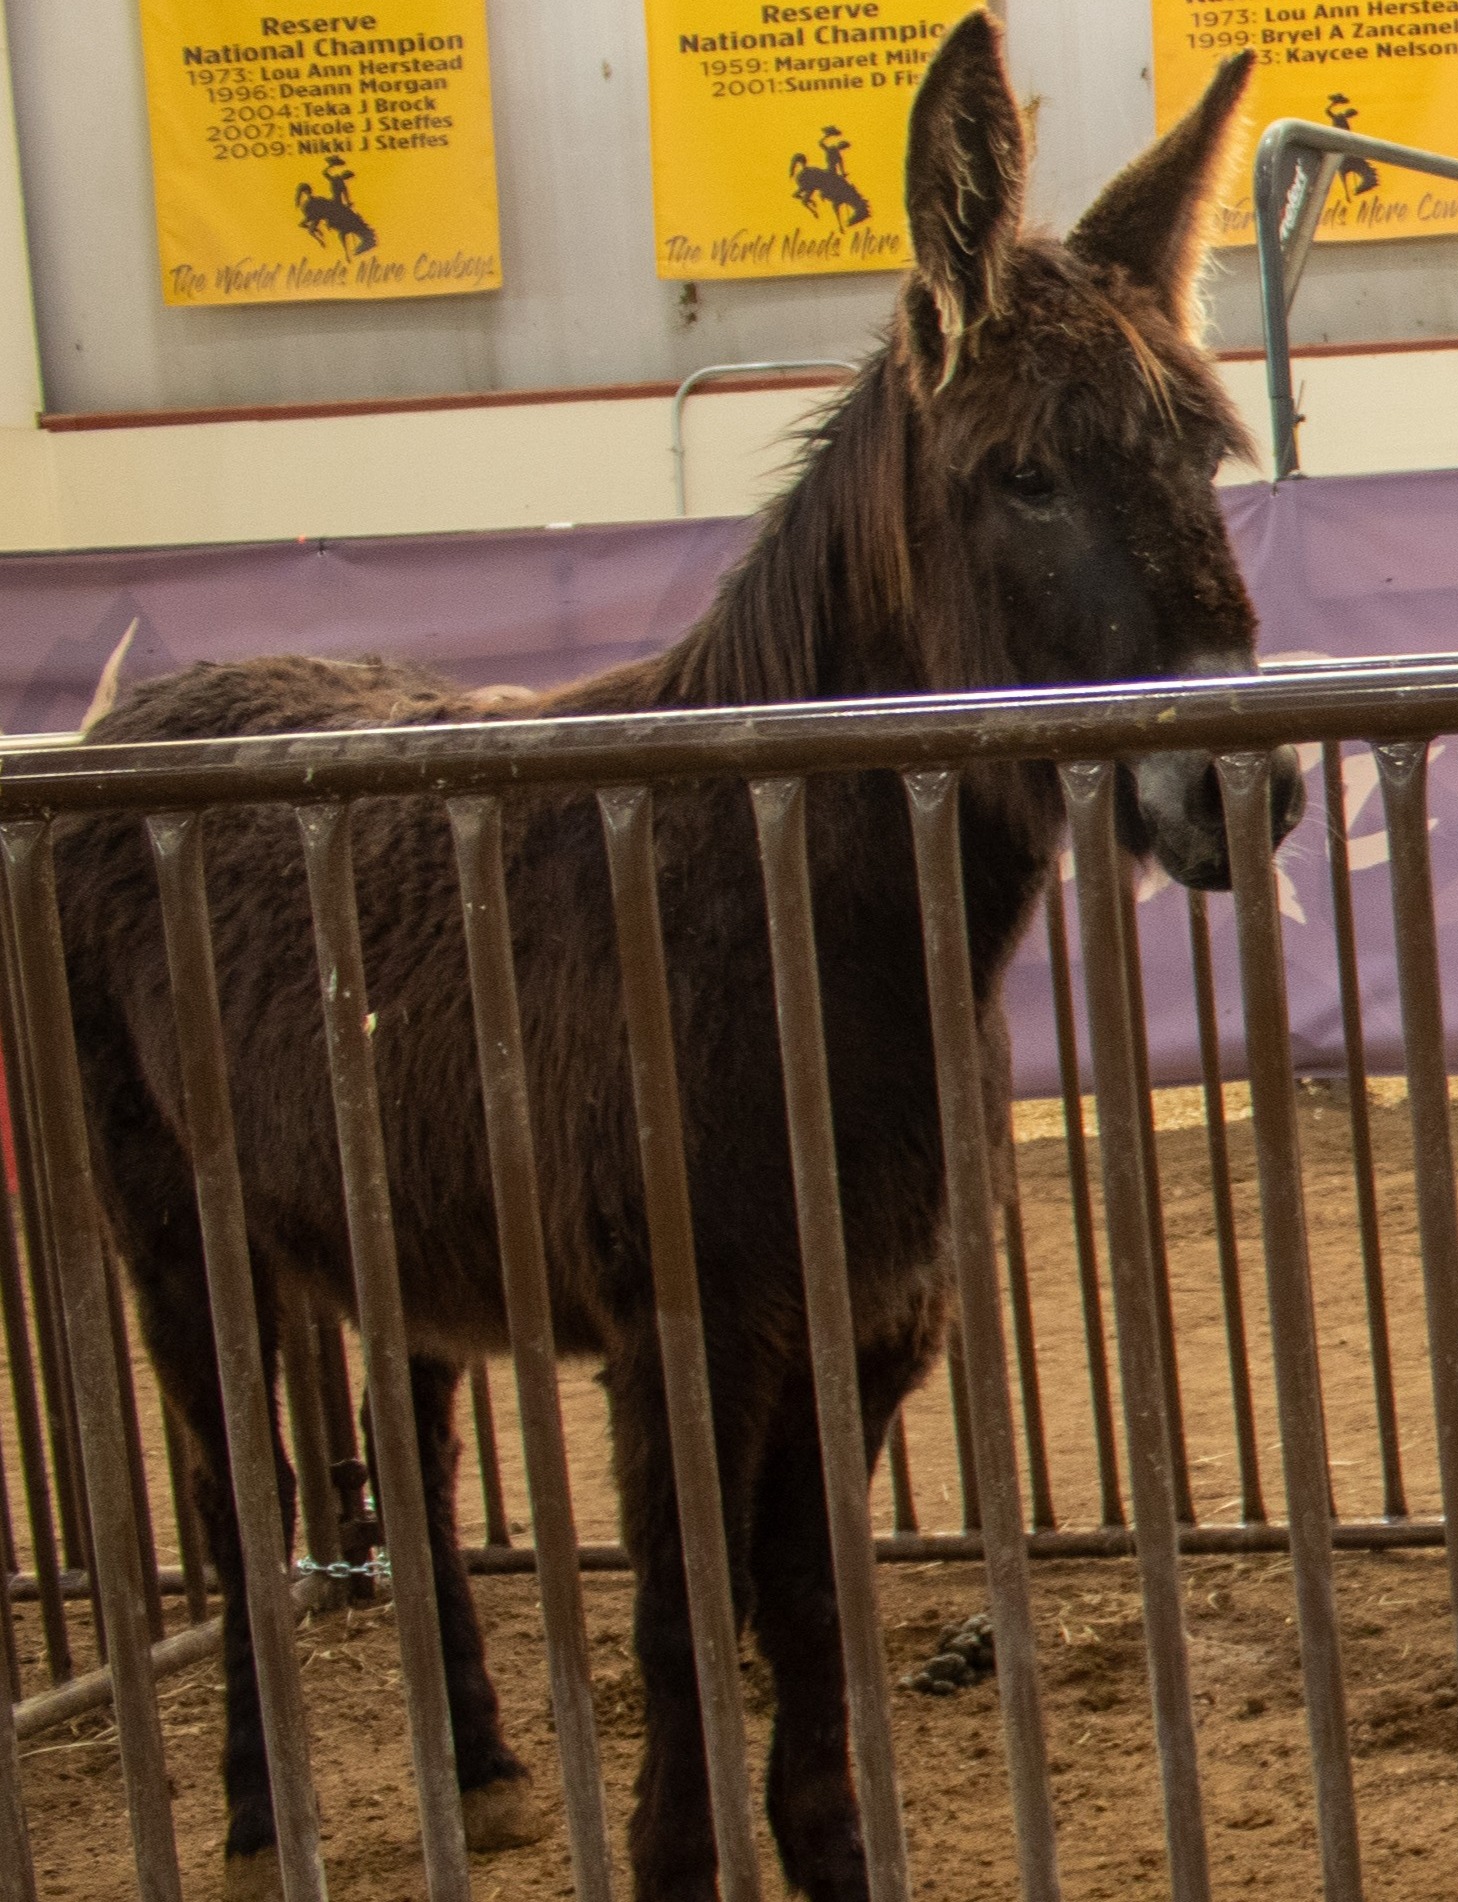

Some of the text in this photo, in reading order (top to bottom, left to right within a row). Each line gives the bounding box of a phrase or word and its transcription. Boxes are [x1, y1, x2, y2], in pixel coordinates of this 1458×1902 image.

[261, 14, 377, 36] Reserve
[761, 2, 879, 24] Reserve
[1192, 9, 1257, 28] 1973:
[1264, 6, 1305, 23] Lou
[1313, 2, 1359, 19] Ann
[182, 33, 463, 65] National Champion
[679, 20, 945, 53] National Champio
[1187, 30, 1256, 50] 1999:
[1261, 25, 1321, 45] Bryel
[1329, 24, 1344, 40] A
[702, 50, 930, 77] 1959: Margaret Mil
[1286, 46, 1369, 65] Kaycee
[1376, 41, 1458, 58] Nelson
[187, 55, 463, 86] 1973: Lou Ann Herstead
[712, 79, 783, 97] 2001:
[785, 74, 863, 92] Sunnie
[871, 72, 886, 87] D
[208, 75, 447, 103] 1996: Deann Morgan
[221, 96, 435, 122] 2004: Teka J Brock
[207, 113, 453, 142] 2007: Nicole J Steffes
[213, 131, 448, 161] 2009: Nikki J Steffes
[1357, 192, 1412, 228] More
[666, 226, 899, 269] The World Needs More
[170, 251, 494, 297] The World Needs More Cowboys
